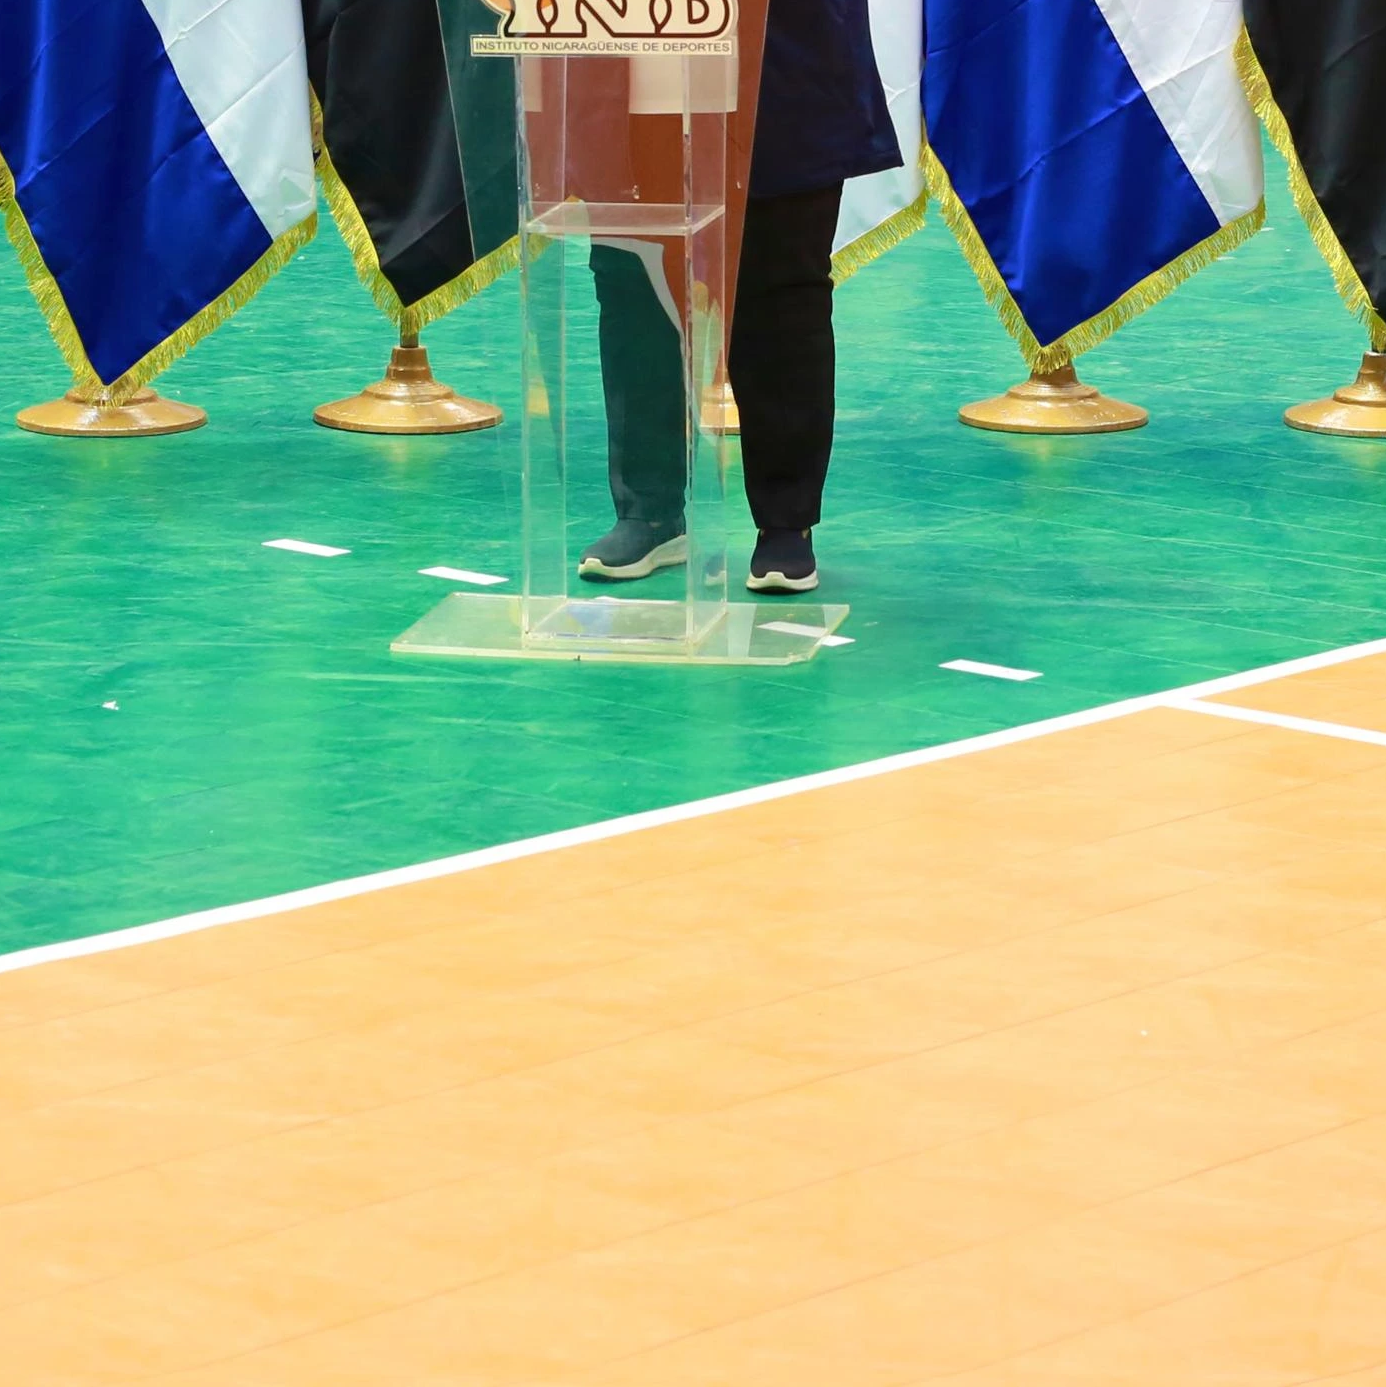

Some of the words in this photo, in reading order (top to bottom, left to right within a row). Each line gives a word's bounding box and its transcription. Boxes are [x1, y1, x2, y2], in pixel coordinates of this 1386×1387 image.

[474, 40, 539, 53] INSTITUTO
[541, 39, 639, 53] NICARAGÜENSE
[641, 41, 660, 53] DE
[662, 41, 730, 54] DEPORTES
